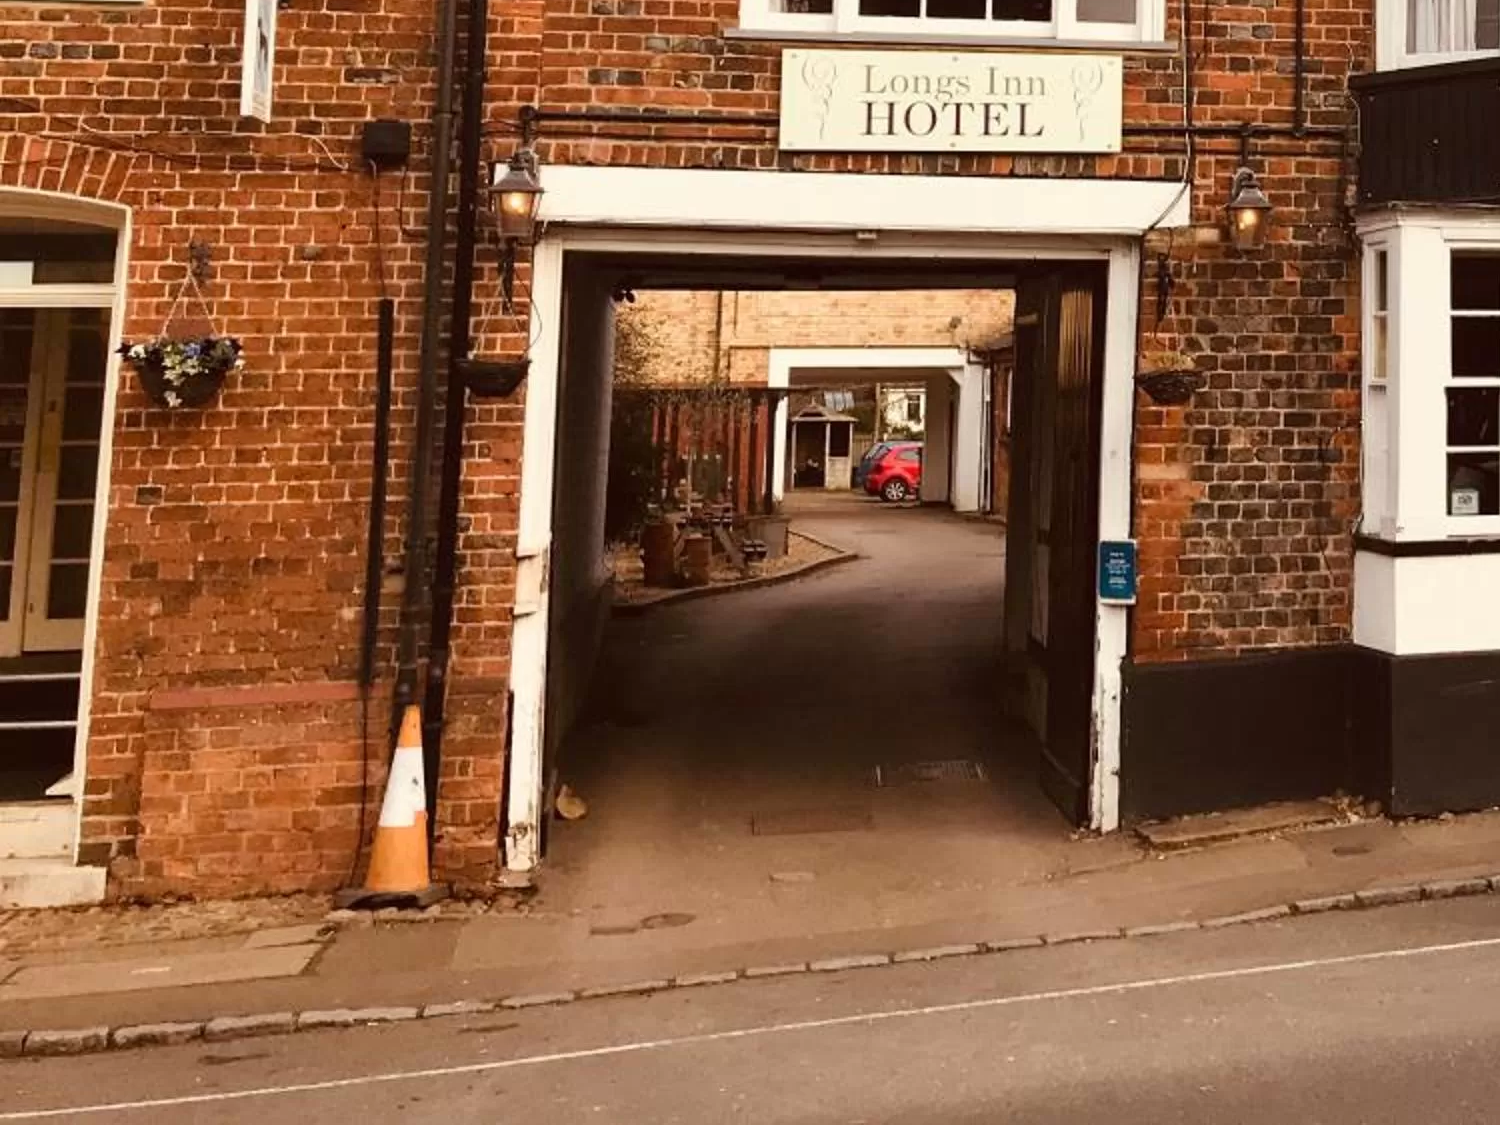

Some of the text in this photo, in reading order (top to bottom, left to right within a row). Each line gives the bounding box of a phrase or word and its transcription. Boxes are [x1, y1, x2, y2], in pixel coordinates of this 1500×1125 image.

[863, 64, 1047, 102] Longs Inn
[860, 101, 1045, 137] HOTEL
